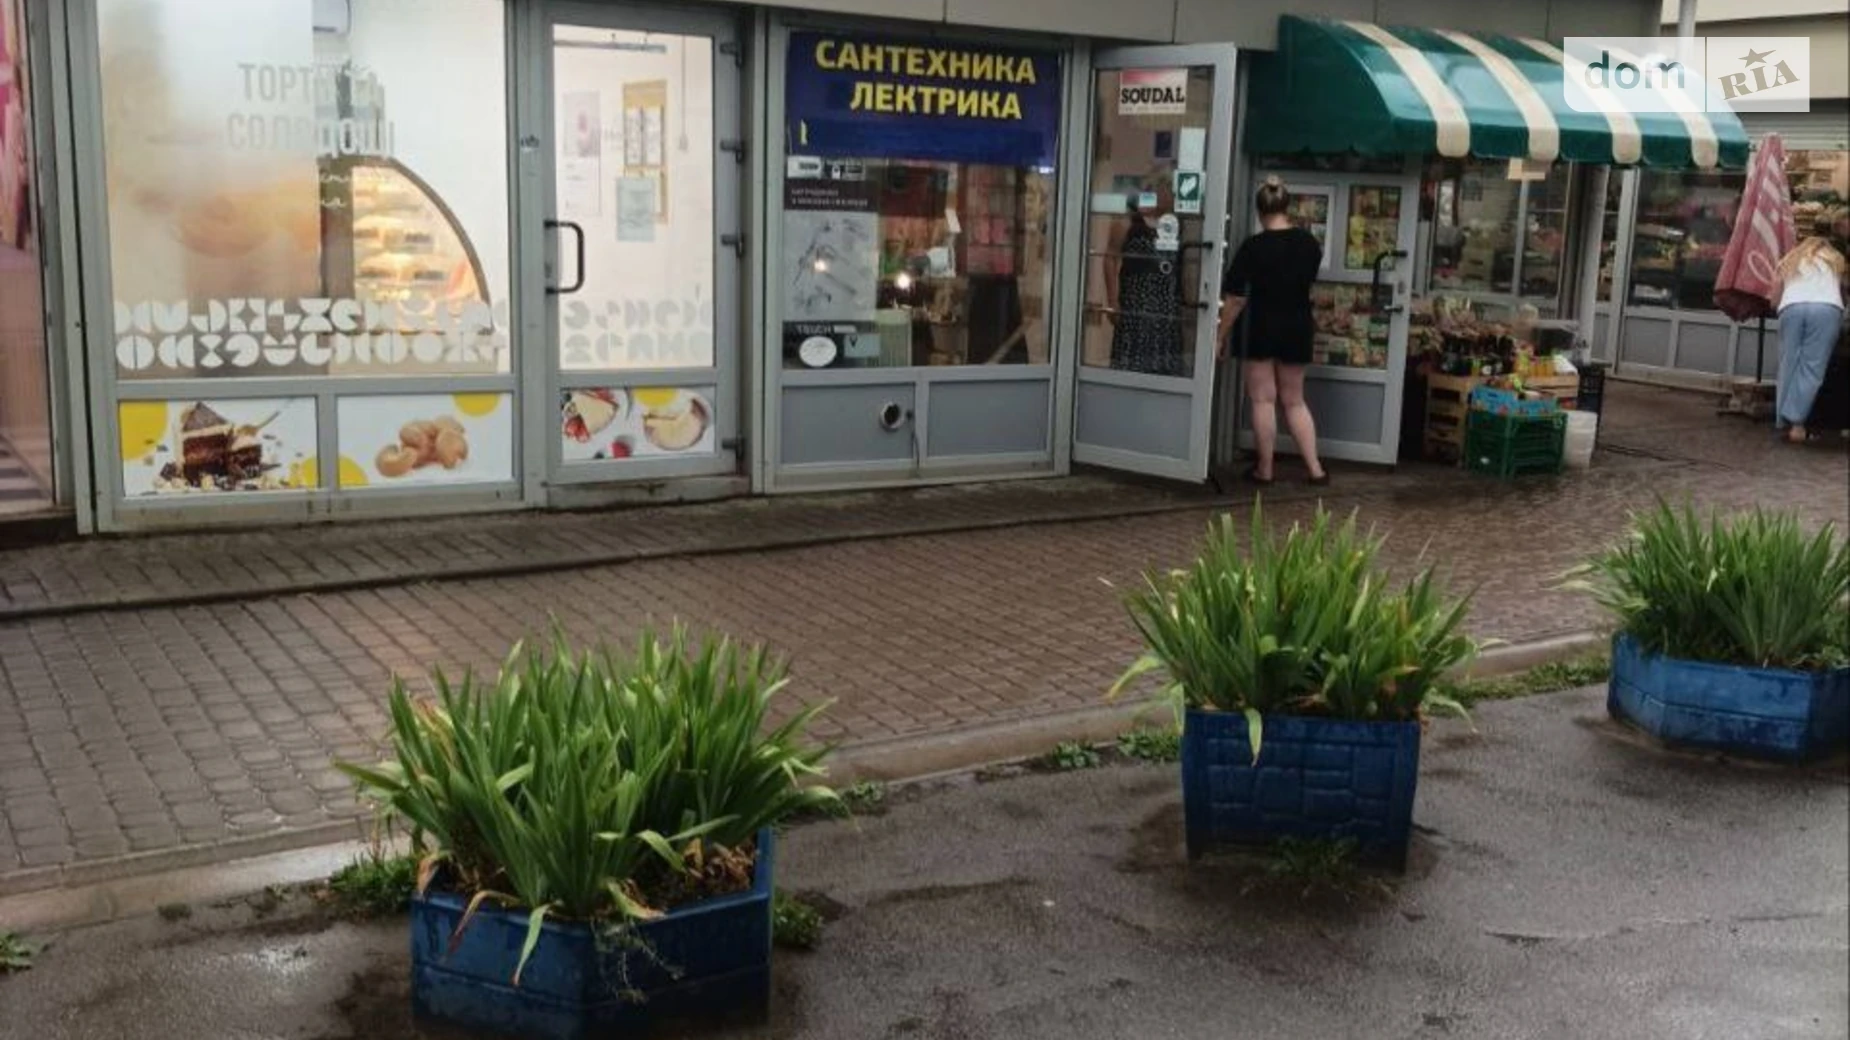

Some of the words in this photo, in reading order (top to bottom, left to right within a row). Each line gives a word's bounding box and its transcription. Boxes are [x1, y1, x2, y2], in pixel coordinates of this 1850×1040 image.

[815, 39, 1036, 84] САНТЕХНИКА
[850, 82, 1022, 120] ЛЕКТРИКА
[1121, 86, 1185, 105] SOUDAL
